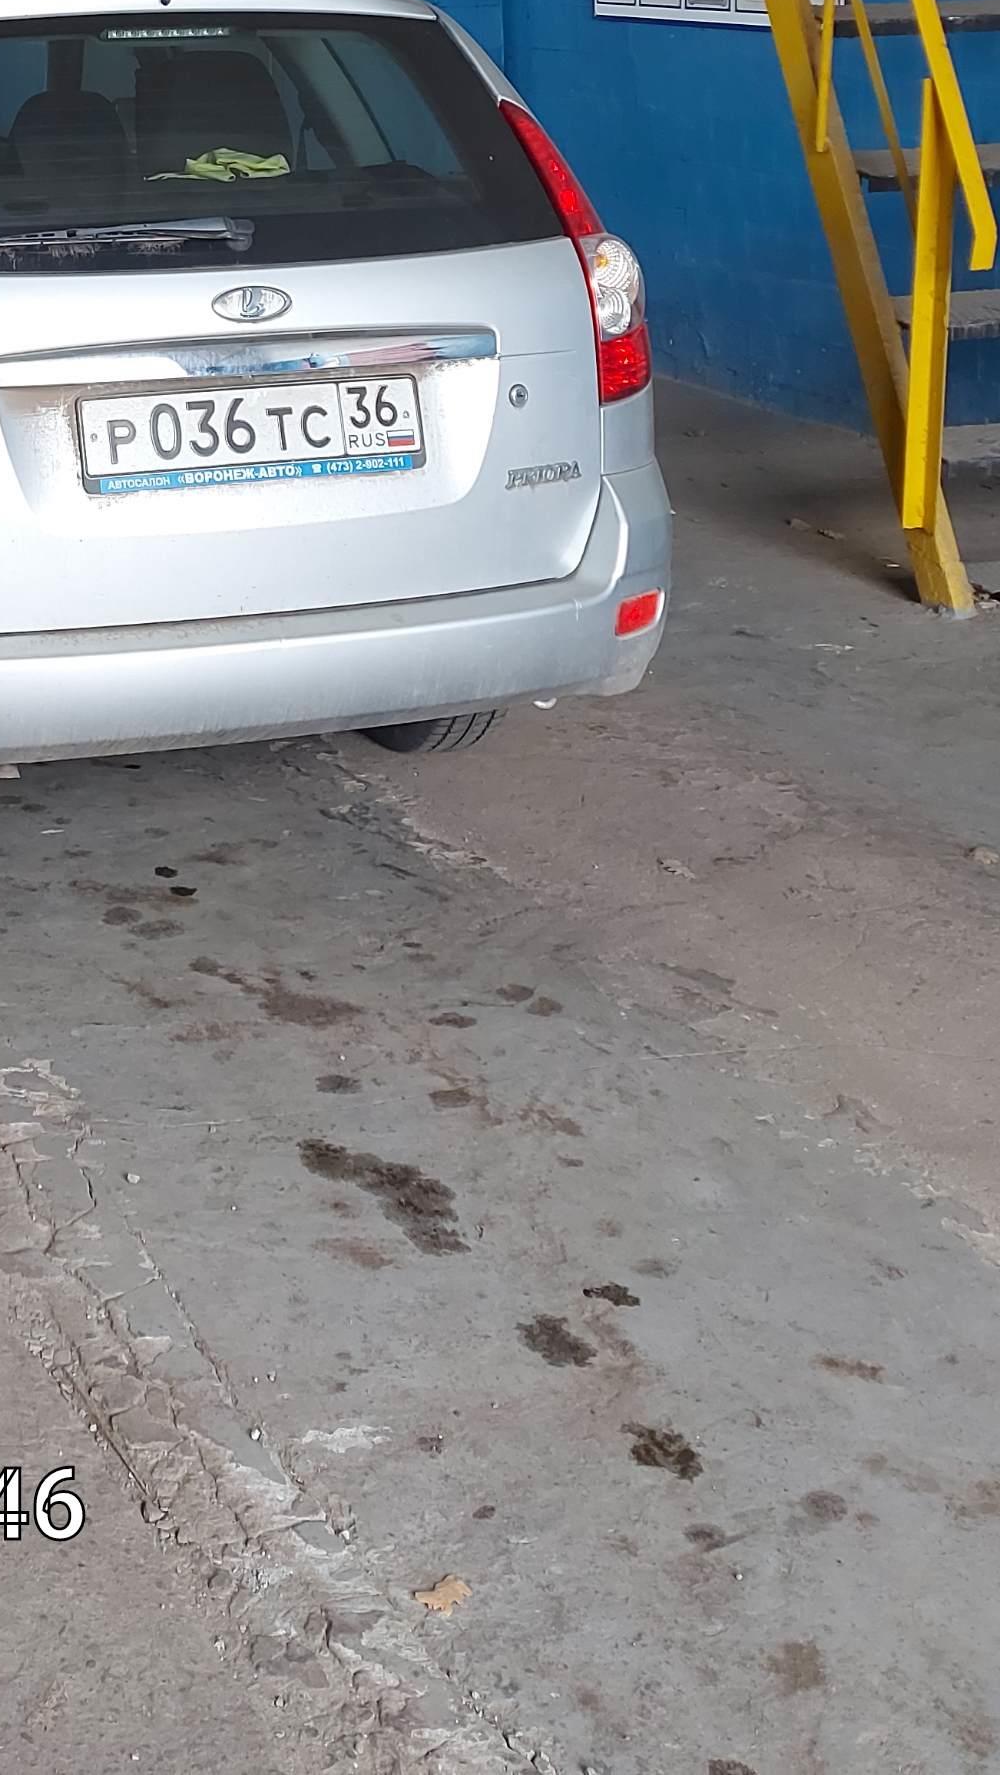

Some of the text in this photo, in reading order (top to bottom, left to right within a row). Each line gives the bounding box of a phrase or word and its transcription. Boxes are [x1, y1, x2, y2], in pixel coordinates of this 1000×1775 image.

[347, 385, 399, 429] 36
[349, 434, 386, 449] RUS
[107, 456, 405, 491] АВТОСАЛОН «ВОРОНЕЖ-АВТО» (473) 2-902-111
